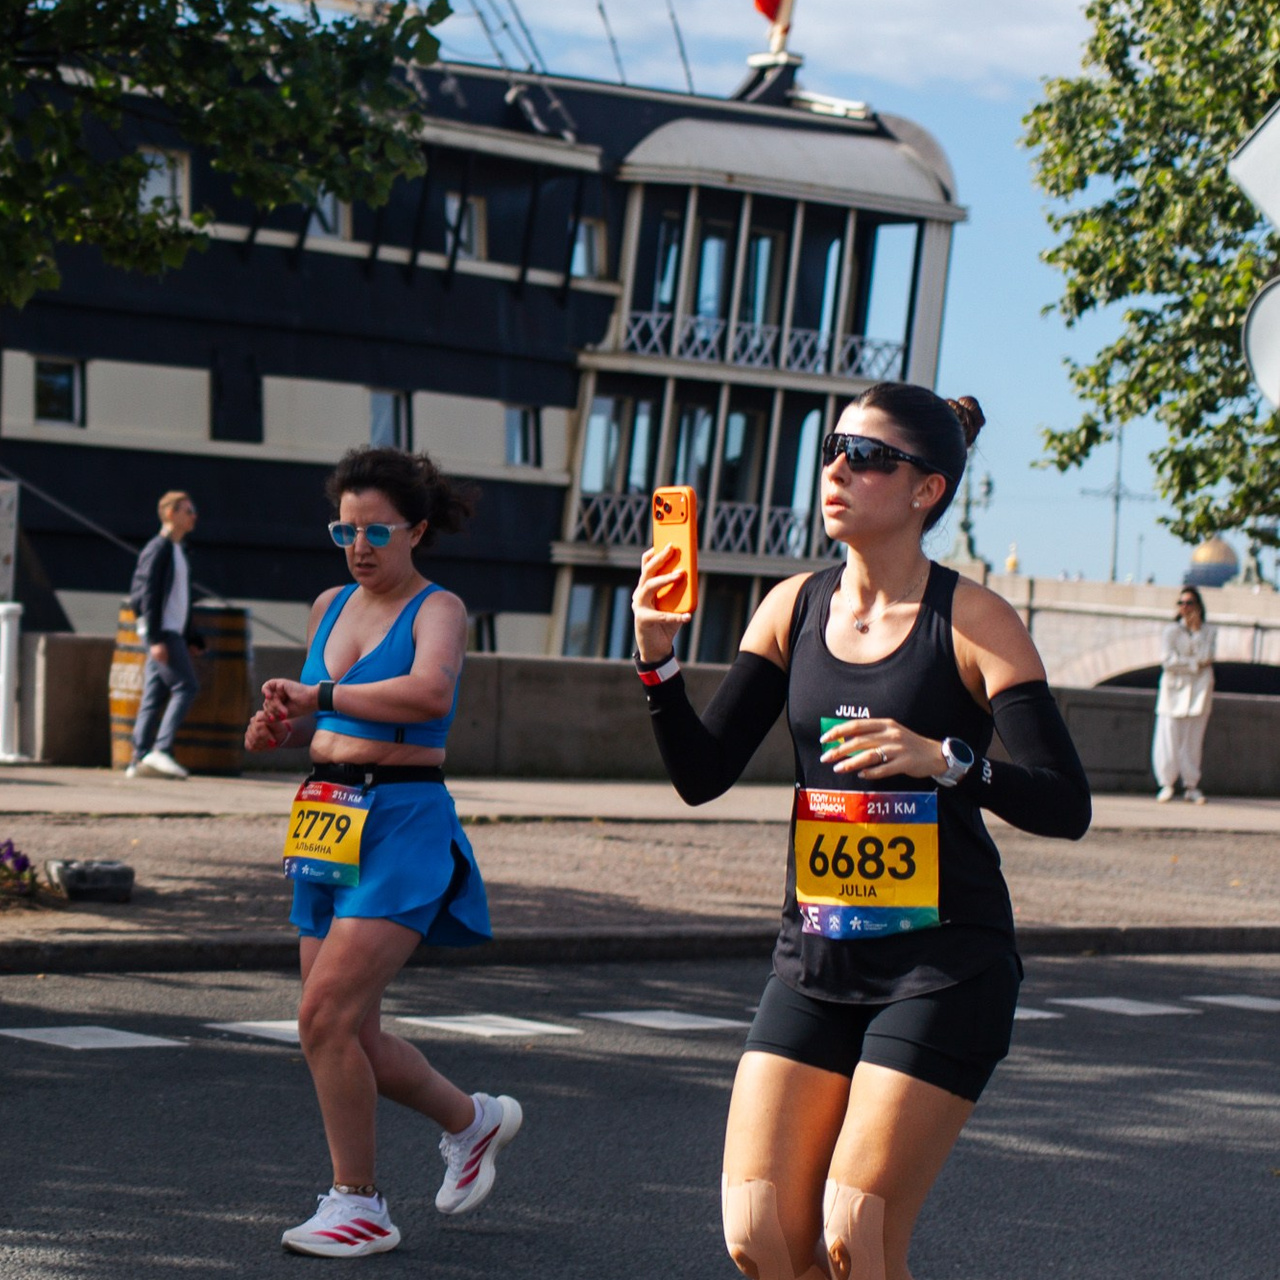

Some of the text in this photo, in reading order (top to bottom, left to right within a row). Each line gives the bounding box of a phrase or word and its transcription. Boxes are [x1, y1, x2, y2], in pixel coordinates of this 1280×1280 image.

[835, 704, 870, 718] JULIA
[867, 801, 890, 816] 21,1
[292, 808, 352, 844] 2779
[295, 841, 332, 855] АЛЬБИНА
[808, 833, 917, 881] 6683
[838, 884, 878, 898] JULIA
